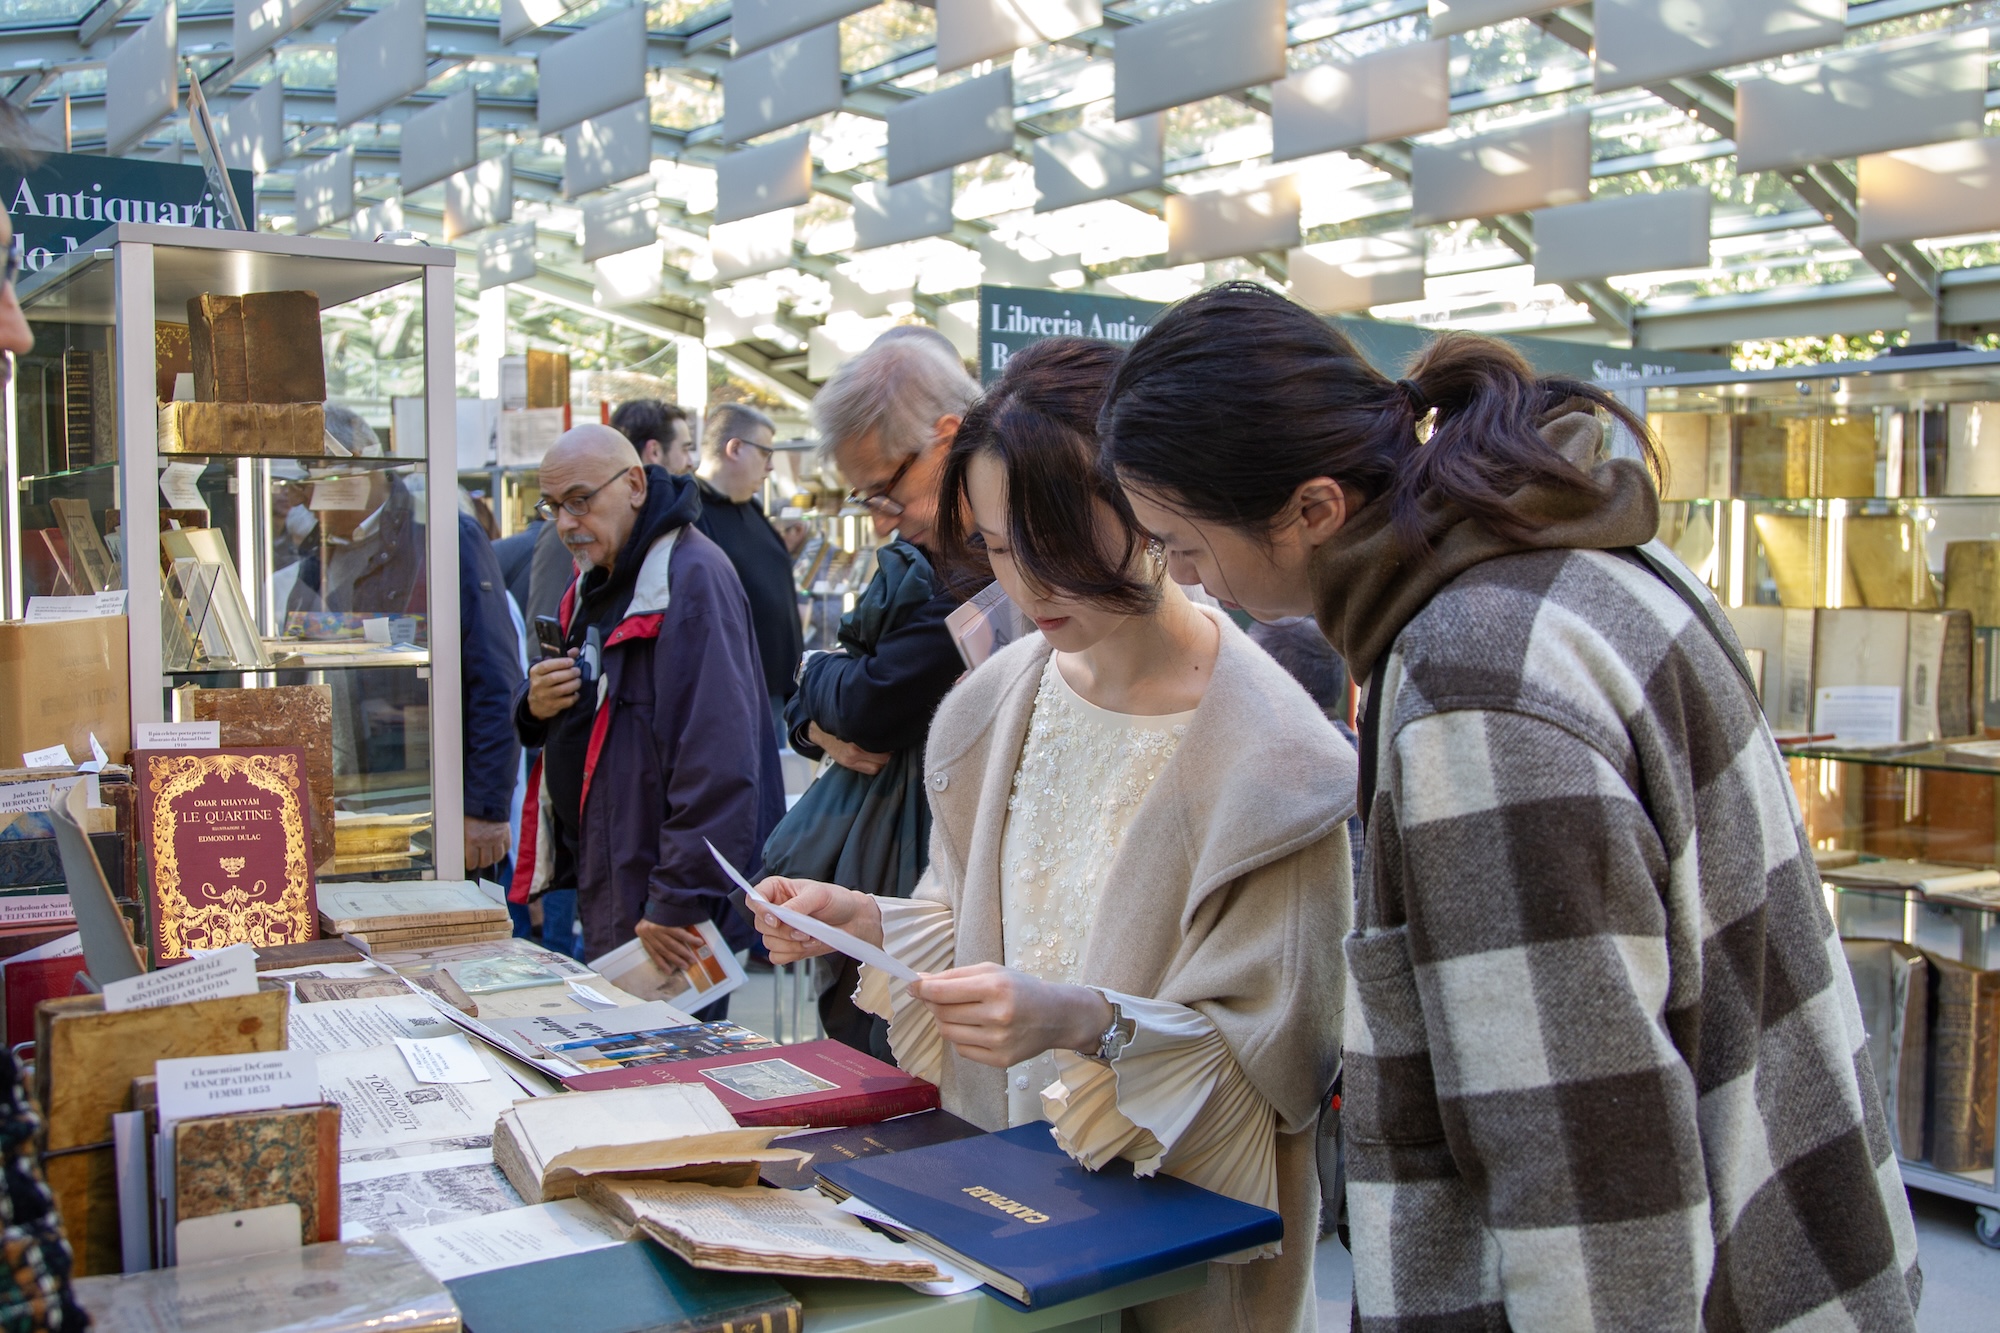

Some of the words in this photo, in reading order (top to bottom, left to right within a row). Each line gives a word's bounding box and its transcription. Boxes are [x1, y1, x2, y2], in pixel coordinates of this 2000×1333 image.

[8, 178, 229, 229] Antiquari
[990, 303, 1083, 337] Libreria
[194, 800, 217, 808] OMAR
[182, 812, 200, 823] LE
[205, 810, 272, 824] QUARTINE
[198, 834, 234, 842] EDMONDO
[146, 958, 222, 986] CANNOCCHIALE
[126, 978, 194, 1004] ARISTOTELICO
[195, 974, 204, 984] di
[204, 967, 237, 982] Tesauro
[182, 986, 211, 1000] AMATO
[214, 979, 230, 991] DA
[184, 1073, 262, 1090] EMANCIPATION
[192, 1064, 242, 1078] Clementine
[208, 1090, 243, 1100] FEMME
[369, 1080, 417, 1130] LEOPOLDO
[961, 1186, 1050, 1224] CAMPARI
